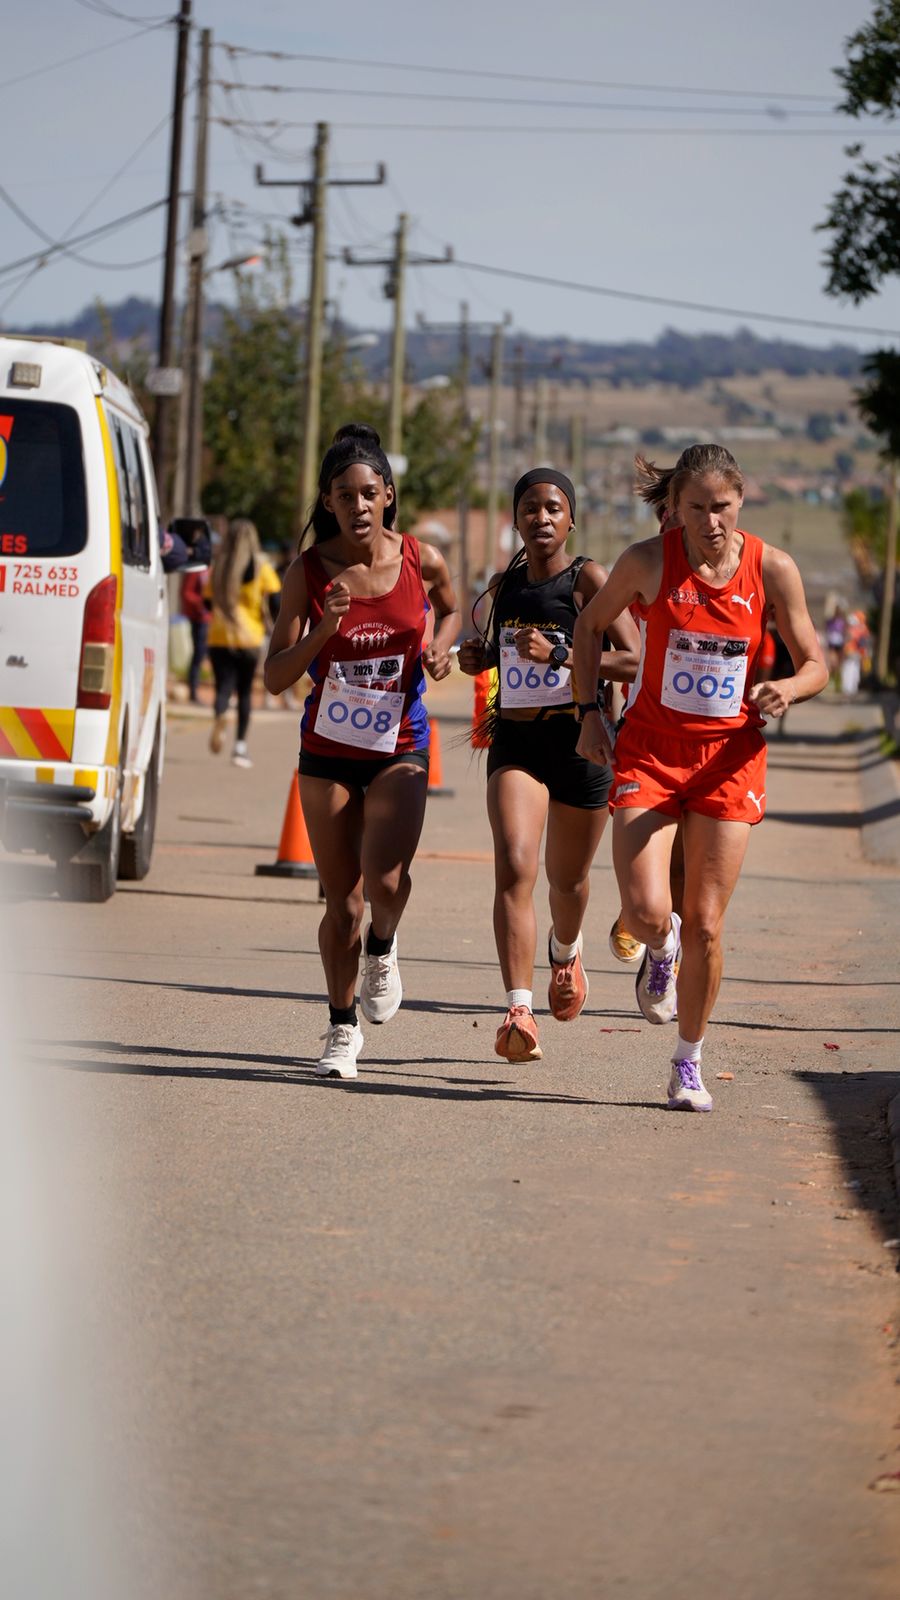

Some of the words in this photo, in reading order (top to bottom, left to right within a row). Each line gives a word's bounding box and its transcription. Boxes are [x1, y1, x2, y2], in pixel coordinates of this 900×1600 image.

[0, 534, 28, 554] ES
[13, 564, 42, 579] 725
[48, 566, 78, 580] 633
[13, 581, 79, 597] RALMED
[697, 640, 718, 652] 2026
[353, 664, 373, 676] 2026
[381, 660, 399, 670] ASA
[506, 664, 560, 690] 066
[673, 671, 735, 699] 005
[328, 701, 392, 733] 008
